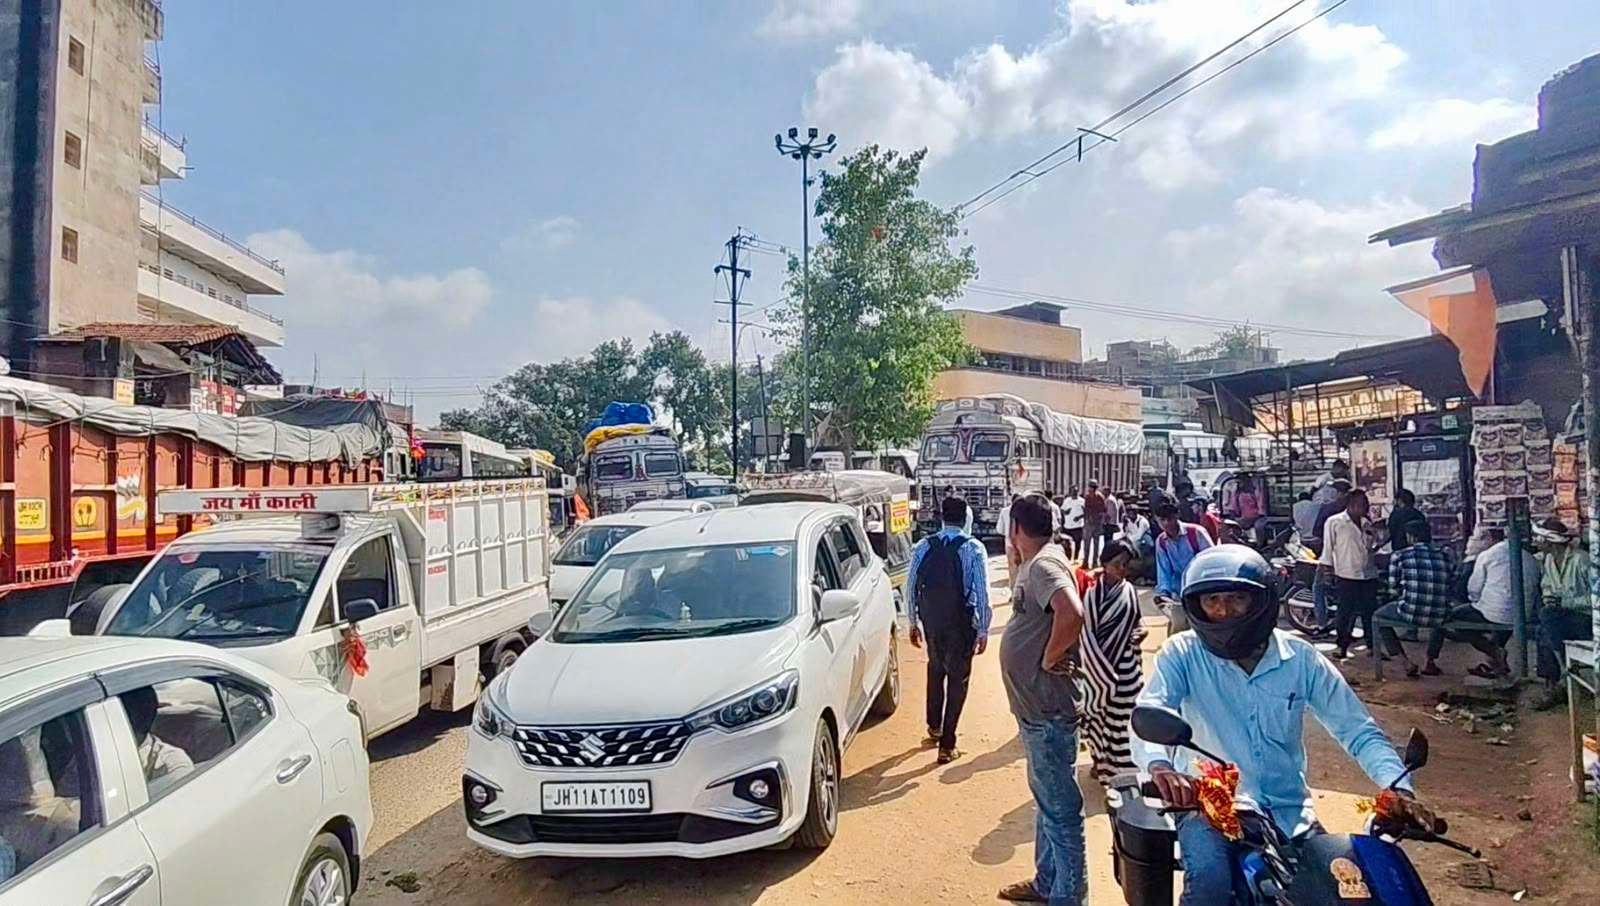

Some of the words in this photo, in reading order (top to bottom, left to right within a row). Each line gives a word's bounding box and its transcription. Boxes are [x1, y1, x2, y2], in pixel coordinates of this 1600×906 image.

[200, 497, 236, 510] जय
[238, 492, 262, 510] माँ
[264, 492, 318, 510] काली
[553, 788, 646, 806] JH11AT1109
